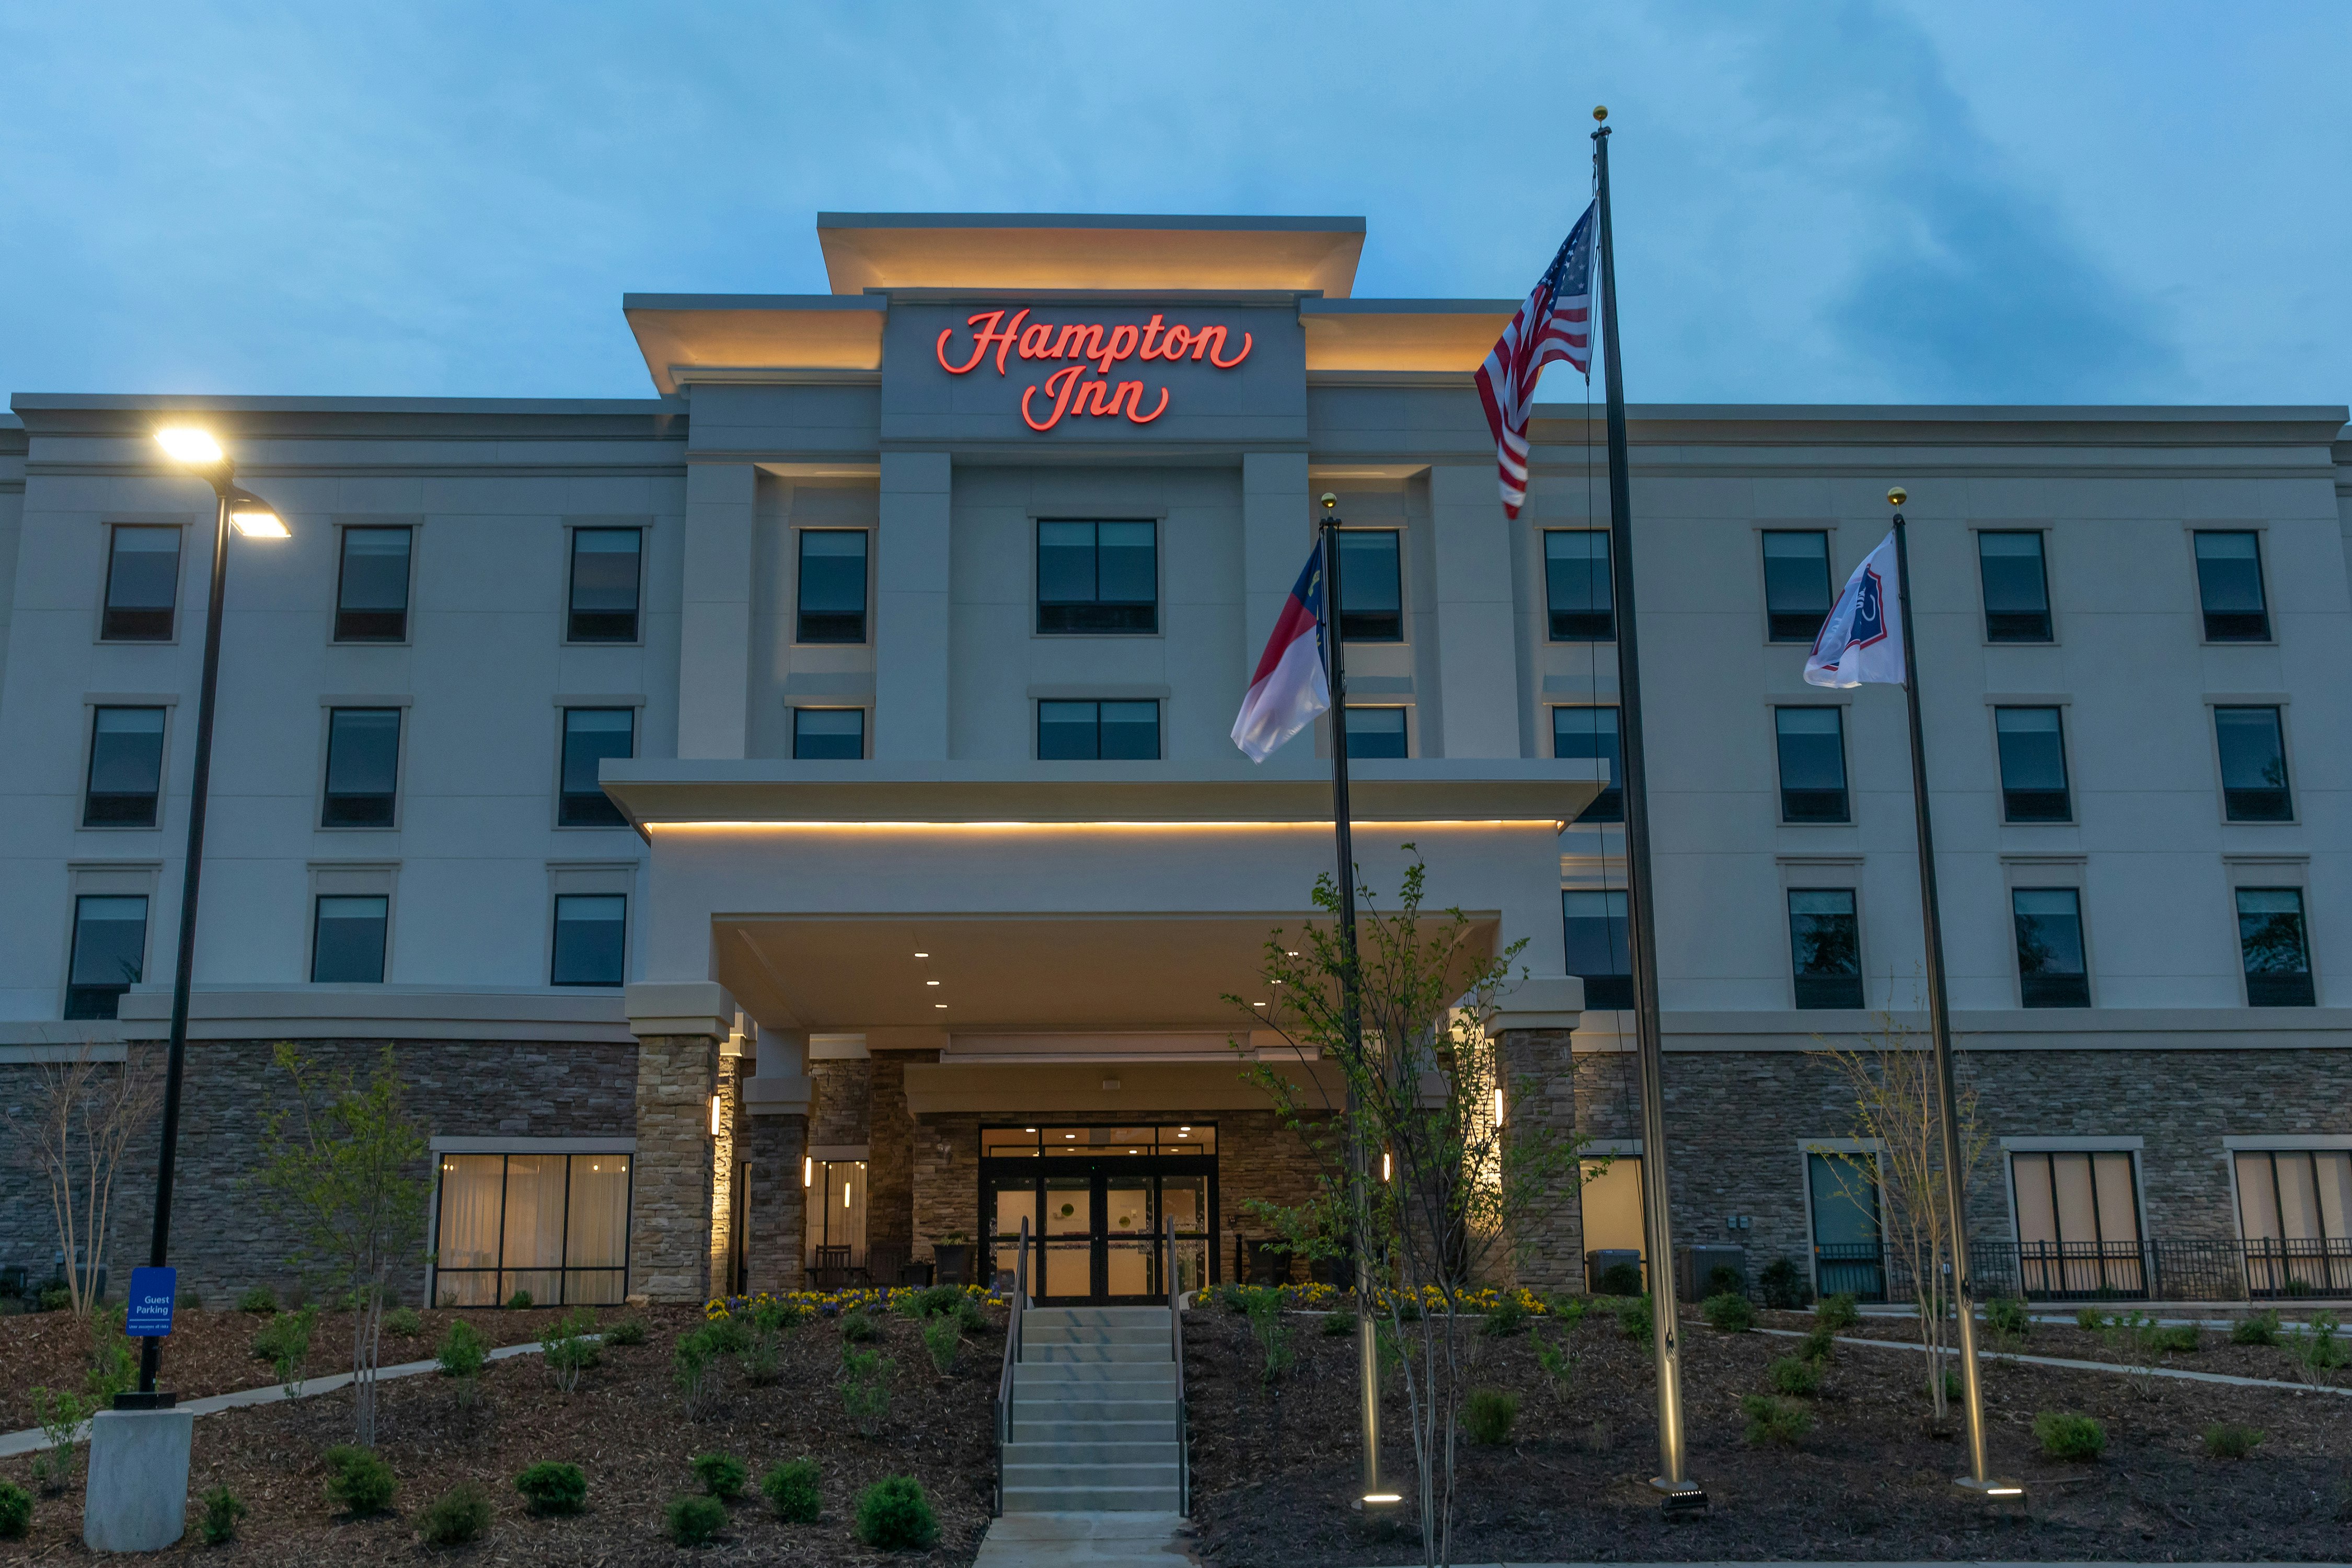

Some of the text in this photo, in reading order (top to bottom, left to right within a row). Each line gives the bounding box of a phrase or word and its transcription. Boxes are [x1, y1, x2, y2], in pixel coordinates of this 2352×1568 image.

[937, 309, 1252, 376] Hampton
[1022, 366, 1169, 431] Inn
[137, 1306, 168, 1316] Parking
